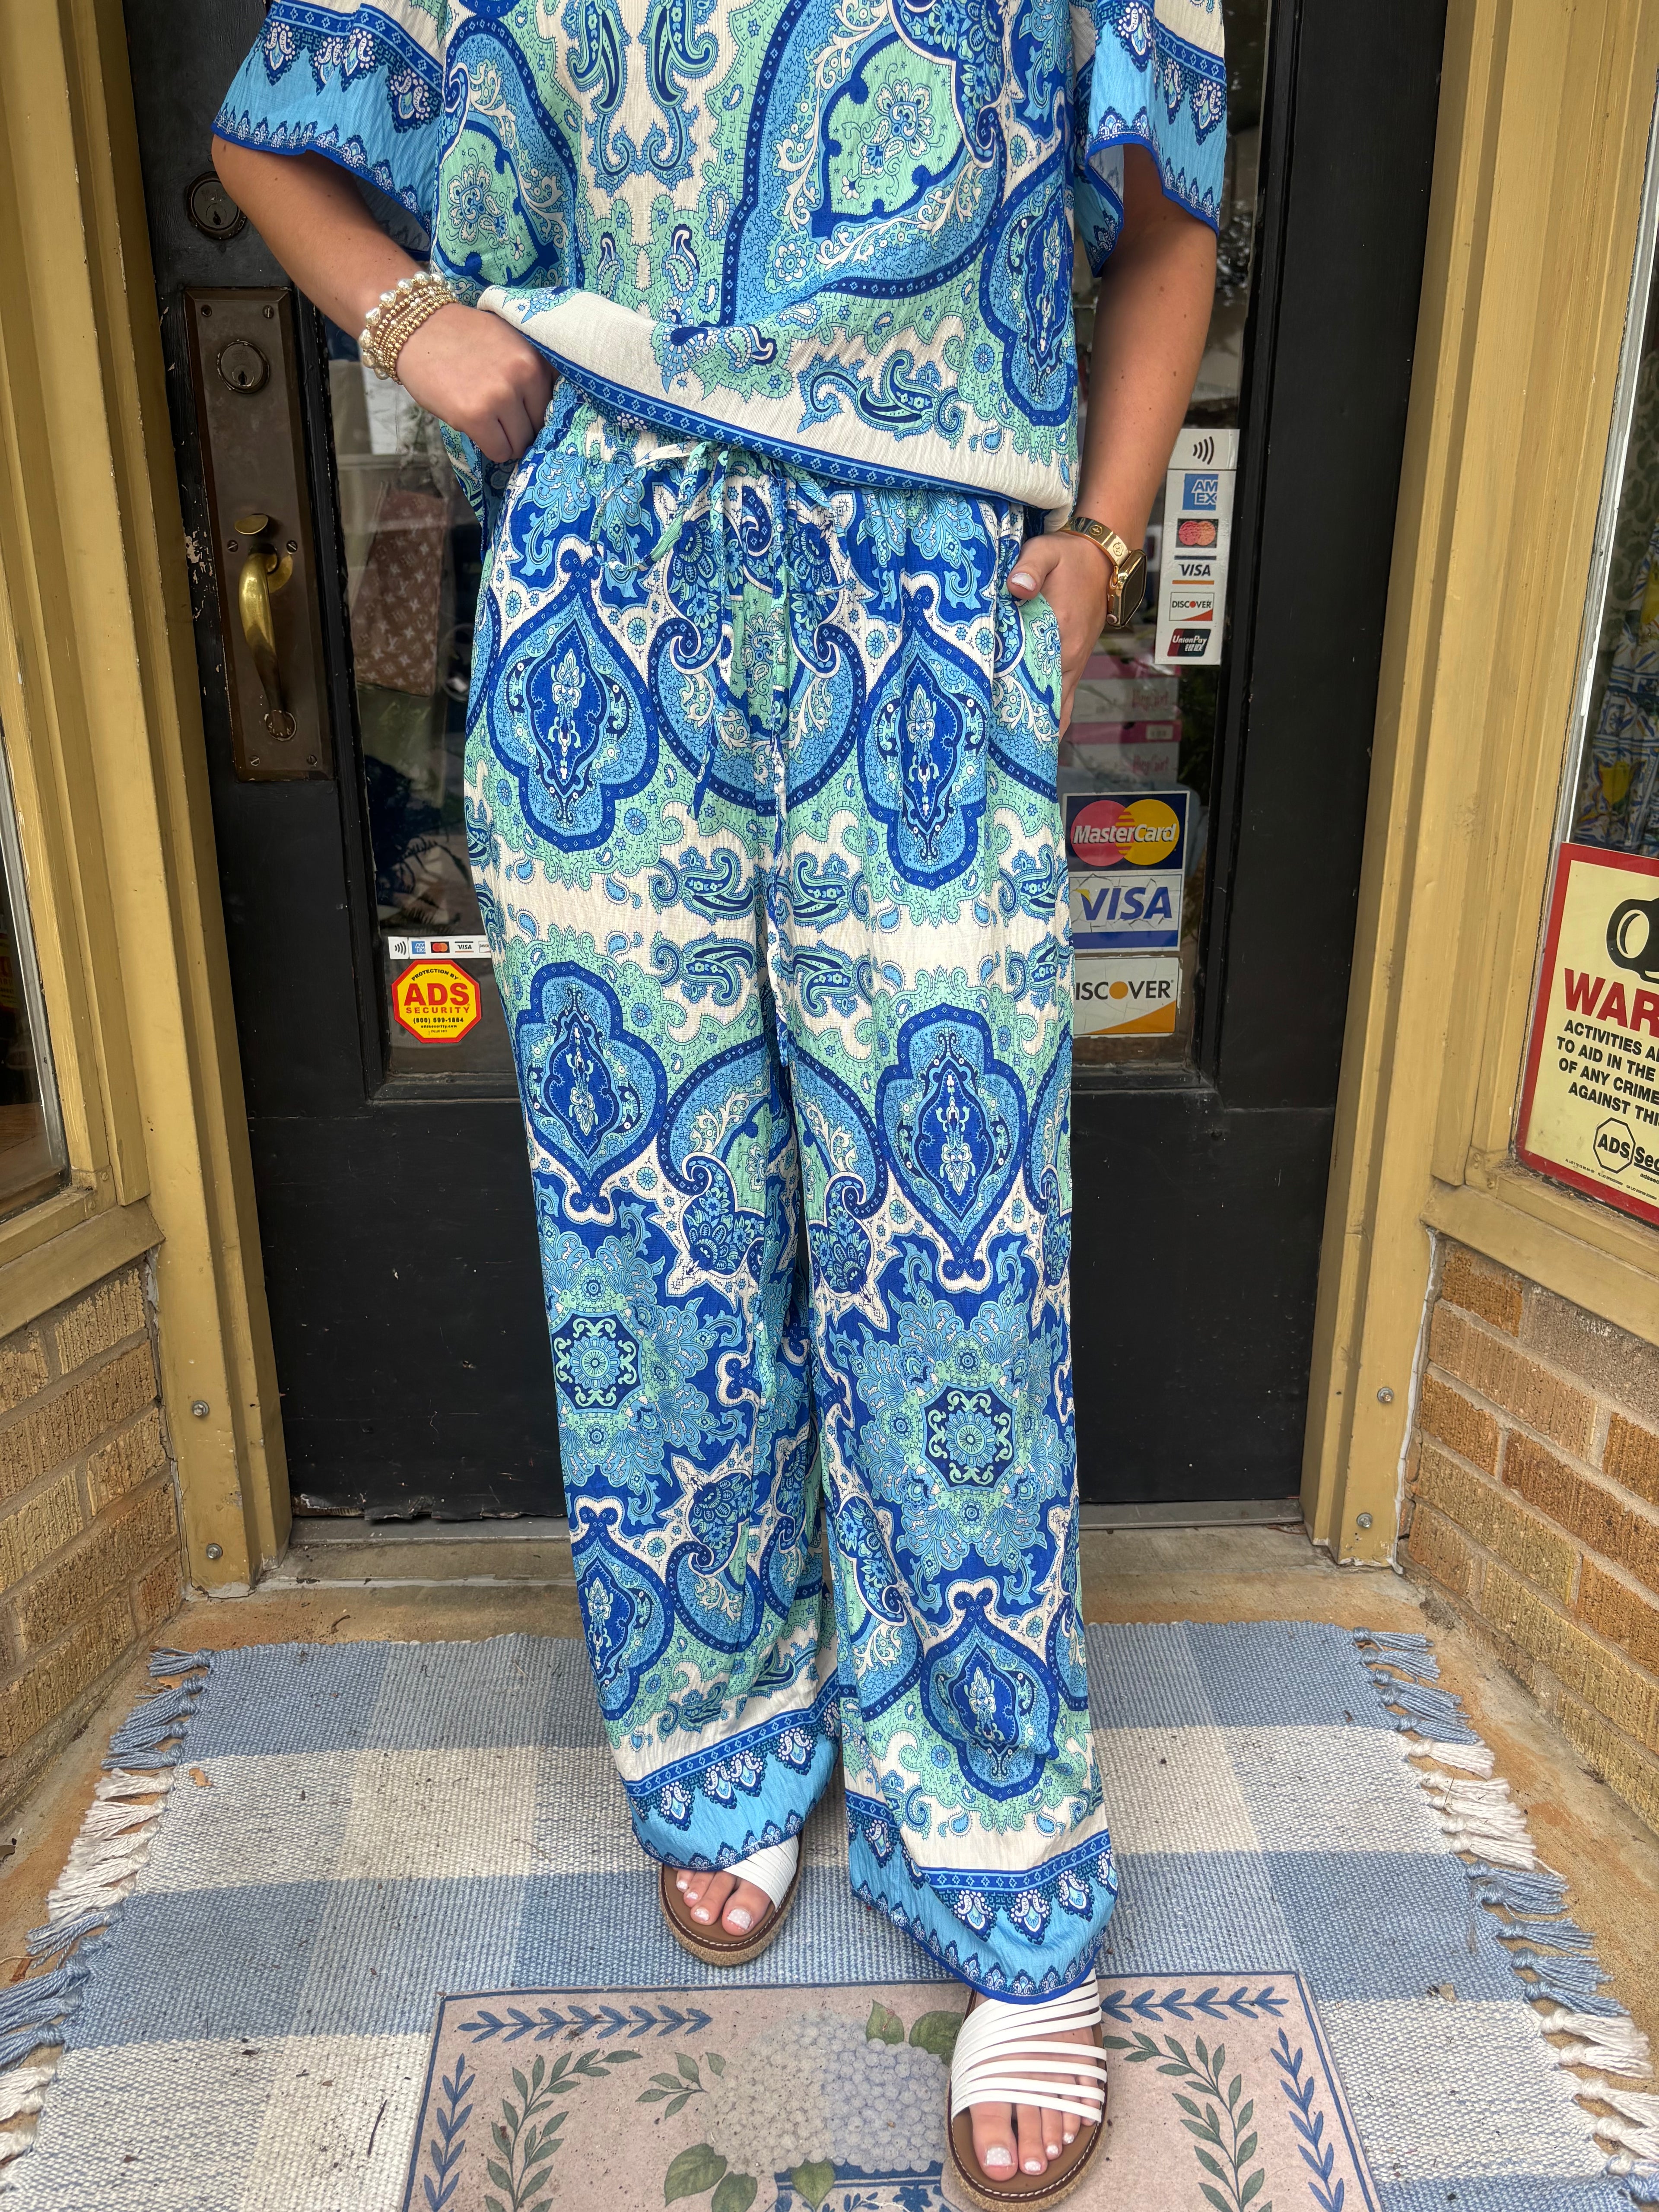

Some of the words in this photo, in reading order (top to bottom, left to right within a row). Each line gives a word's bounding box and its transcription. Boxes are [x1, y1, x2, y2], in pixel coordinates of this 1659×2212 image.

[1191, 479, 1218, 493] AM
[1194, 493, 1217, 505] EX
[1179, 564, 1211, 577] VISA
[1172, 635, 1207, 647] UnionPay
[1072, 823, 1177, 845] MasterCard
[1073, 887, 1173, 921] VISA
[411, 969, 449, 981] PROTECTION
[404, 982, 470, 1006] ADS
[1075, 980, 1171, 1001] ISCOVER
[1564, 967, 1659, 1039] WAR
[1564, 1019, 1642, 1055] ACTIVITIES
[1645, 1046, 1659, 1062] A
[1557, 1036, 1575, 1053] TO
[1578, 1044, 1603, 1063] AID
[1606, 1053, 1622, 1071] IN
[1627, 1059, 1656, 1082] THE
[1559, 1058, 1578, 1074] OF
[1580, 1065, 1611, 1086] ANY
[1613, 1077, 1659, 1106] CRIME
[1568, 1081, 1631, 1115] AGAINST
[1635, 1105, 1659, 1127] THI
[1597, 1133, 1630, 1159] ADS
[1634, 1146, 1659, 1172] Sec
